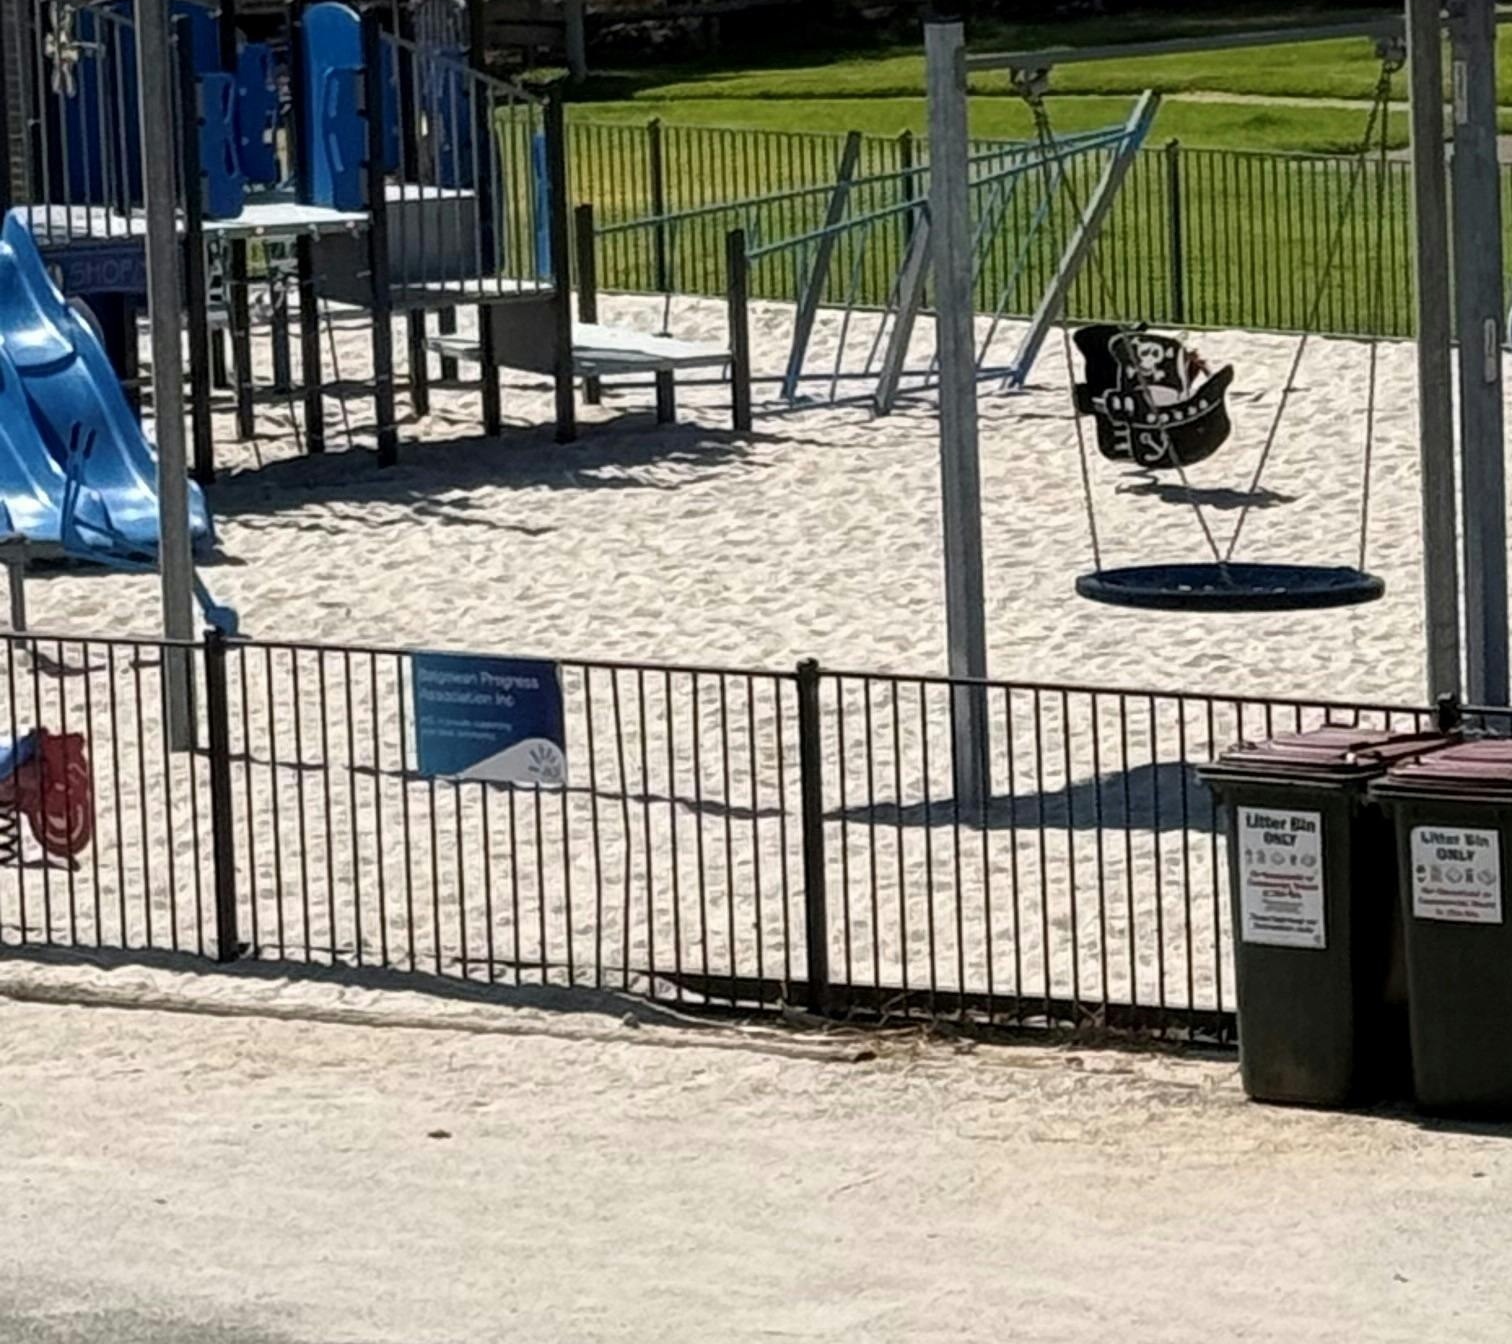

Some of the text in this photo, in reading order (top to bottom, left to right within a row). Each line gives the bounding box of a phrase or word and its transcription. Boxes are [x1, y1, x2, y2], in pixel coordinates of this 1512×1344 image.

[480, 671, 539, 691] Progress
[1246, 812, 1287, 831] Litter
[1436, 847, 1475, 862] ONLY
